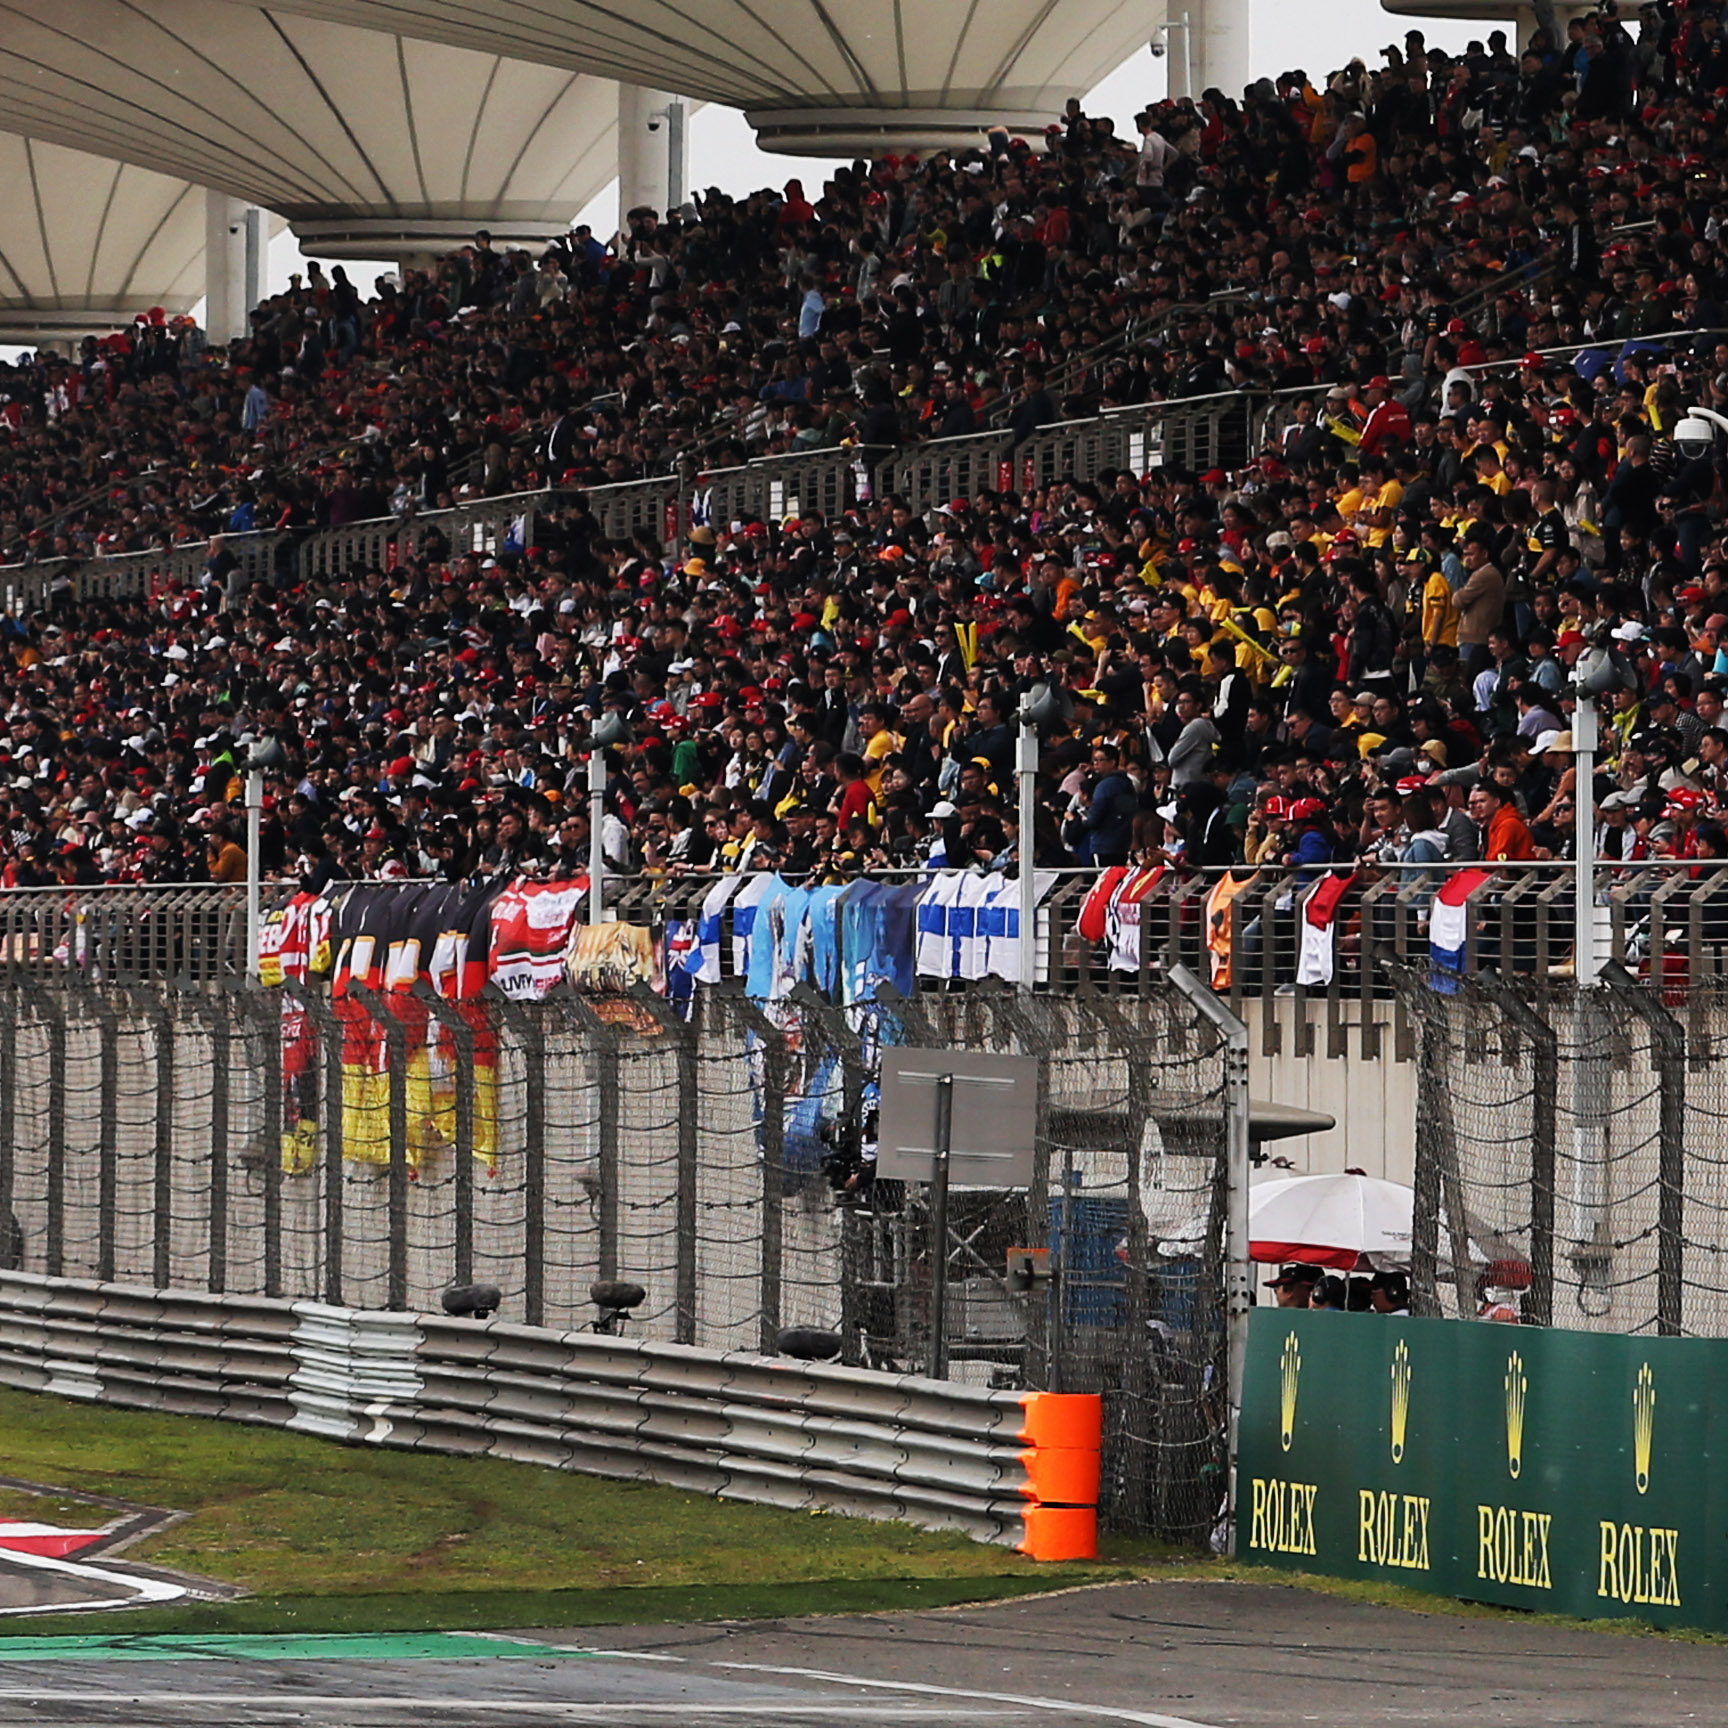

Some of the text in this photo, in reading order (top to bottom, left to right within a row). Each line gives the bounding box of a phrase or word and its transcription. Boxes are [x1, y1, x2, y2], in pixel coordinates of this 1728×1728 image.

[1249, 1478, 1318, 1555] ROLEX
[1358, 1489, 1430, 1570] ROLEX
[1477, 1505, 1552, 1589] ROLEX
[1597, 1521, 1681, 1607] ROLEX
